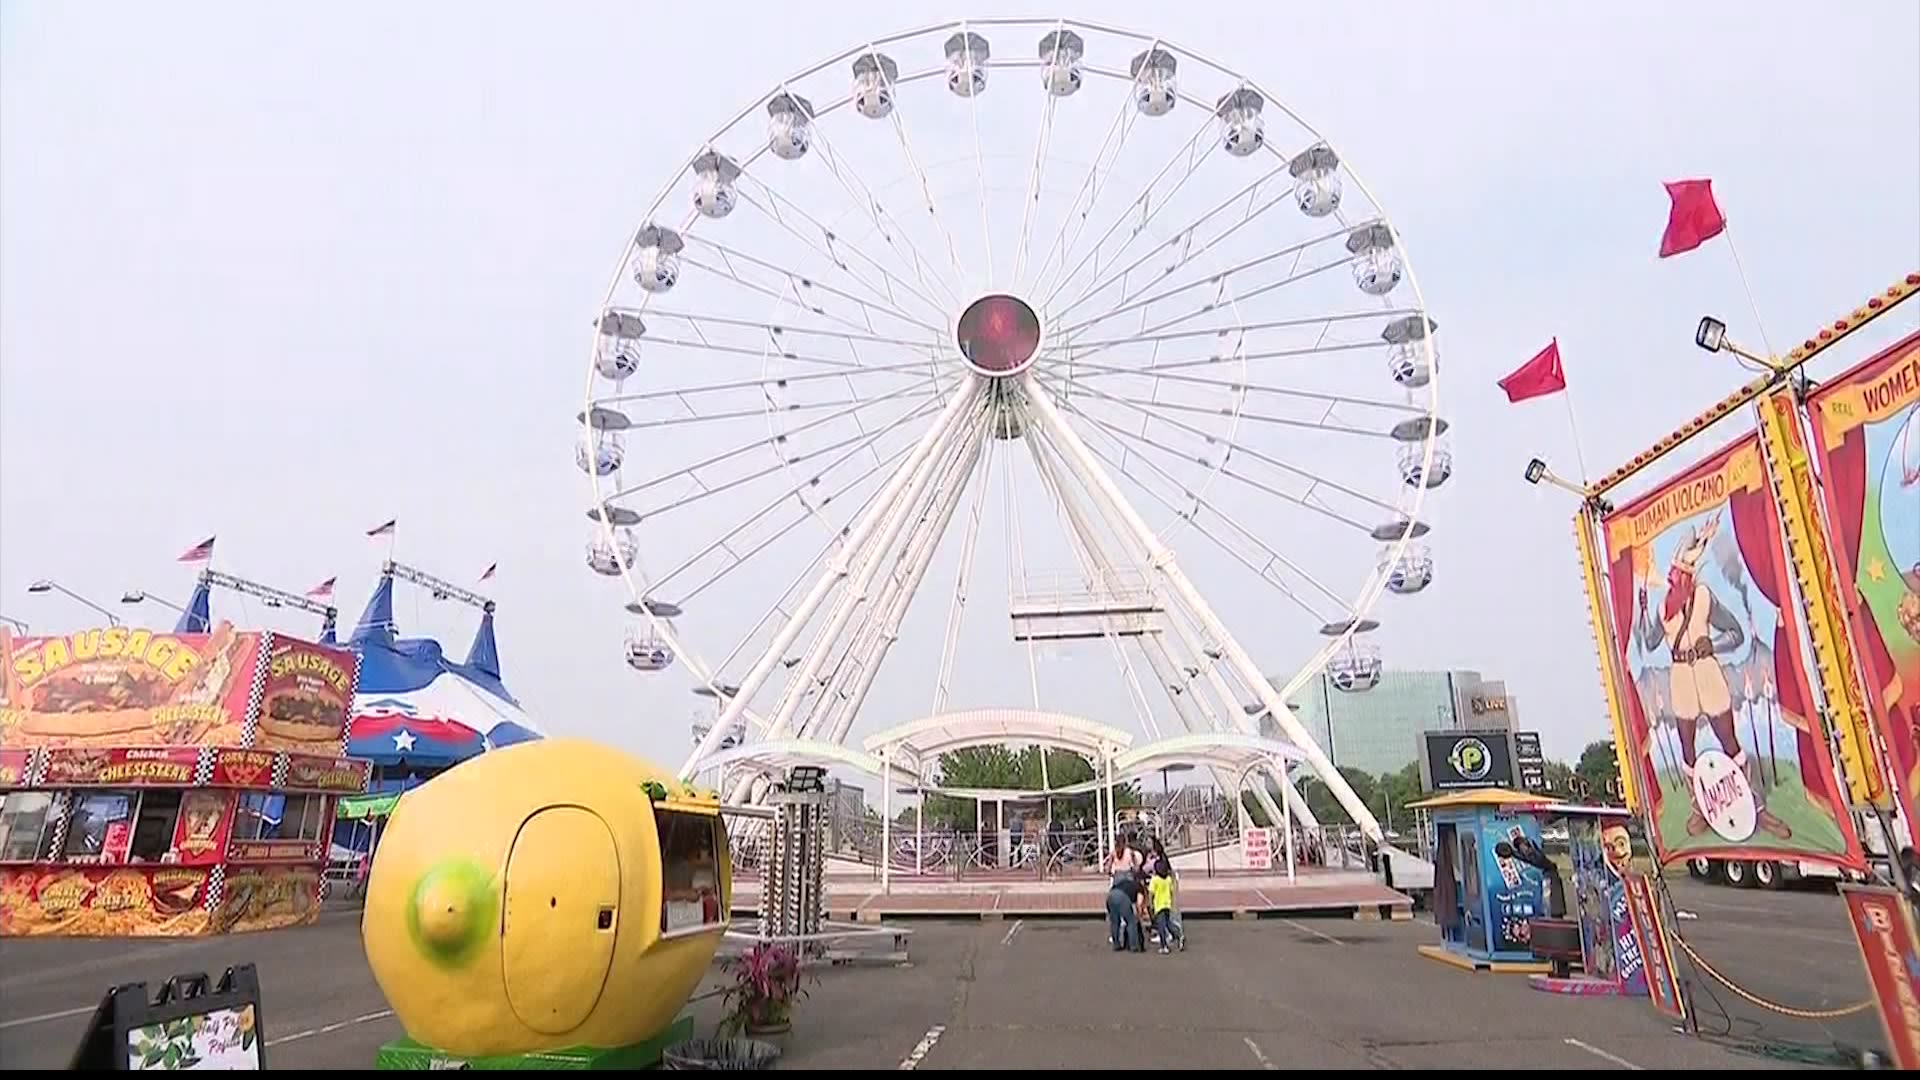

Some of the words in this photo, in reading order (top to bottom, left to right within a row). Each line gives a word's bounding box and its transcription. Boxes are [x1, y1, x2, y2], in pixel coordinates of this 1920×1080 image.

[1634, 498, 1670, 540] HUMAN
[1672, 474, 1725, 515] VOLCANO
[13, 626, 202, 688] SAUSAGE
[271, 653, 349, 692] SAUSAGE
[1485, 699, 1505, 711] LIVE
[125, 749, 169, 759] Chicken
[99, 761, 191, 782] CHEESESTEAK
[1621, 945, 1640, 966] THE
